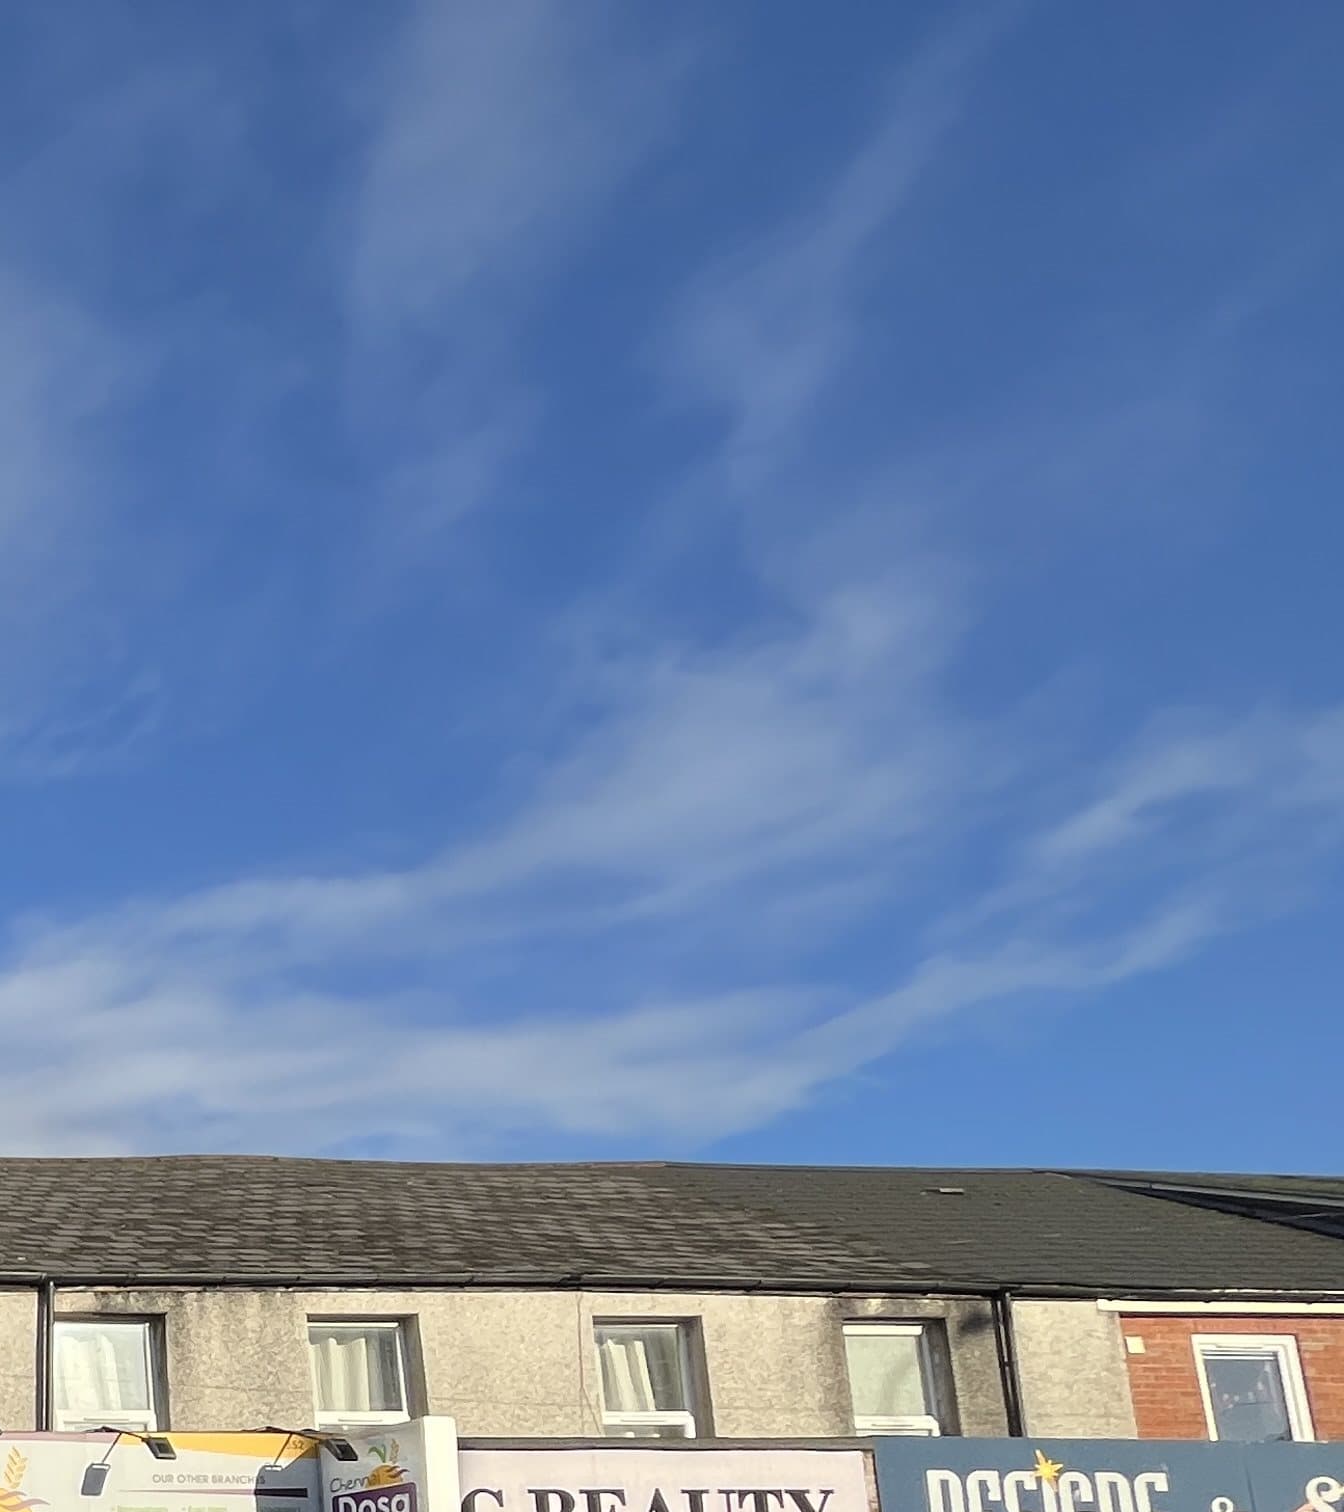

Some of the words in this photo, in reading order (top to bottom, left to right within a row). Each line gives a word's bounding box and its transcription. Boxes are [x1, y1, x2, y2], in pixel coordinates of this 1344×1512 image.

[152, 1474, 174, 1483] OUR
[177, 1474, 210, 1483] OTHER
[211, 1474, 266, 1485] BRANCHS
